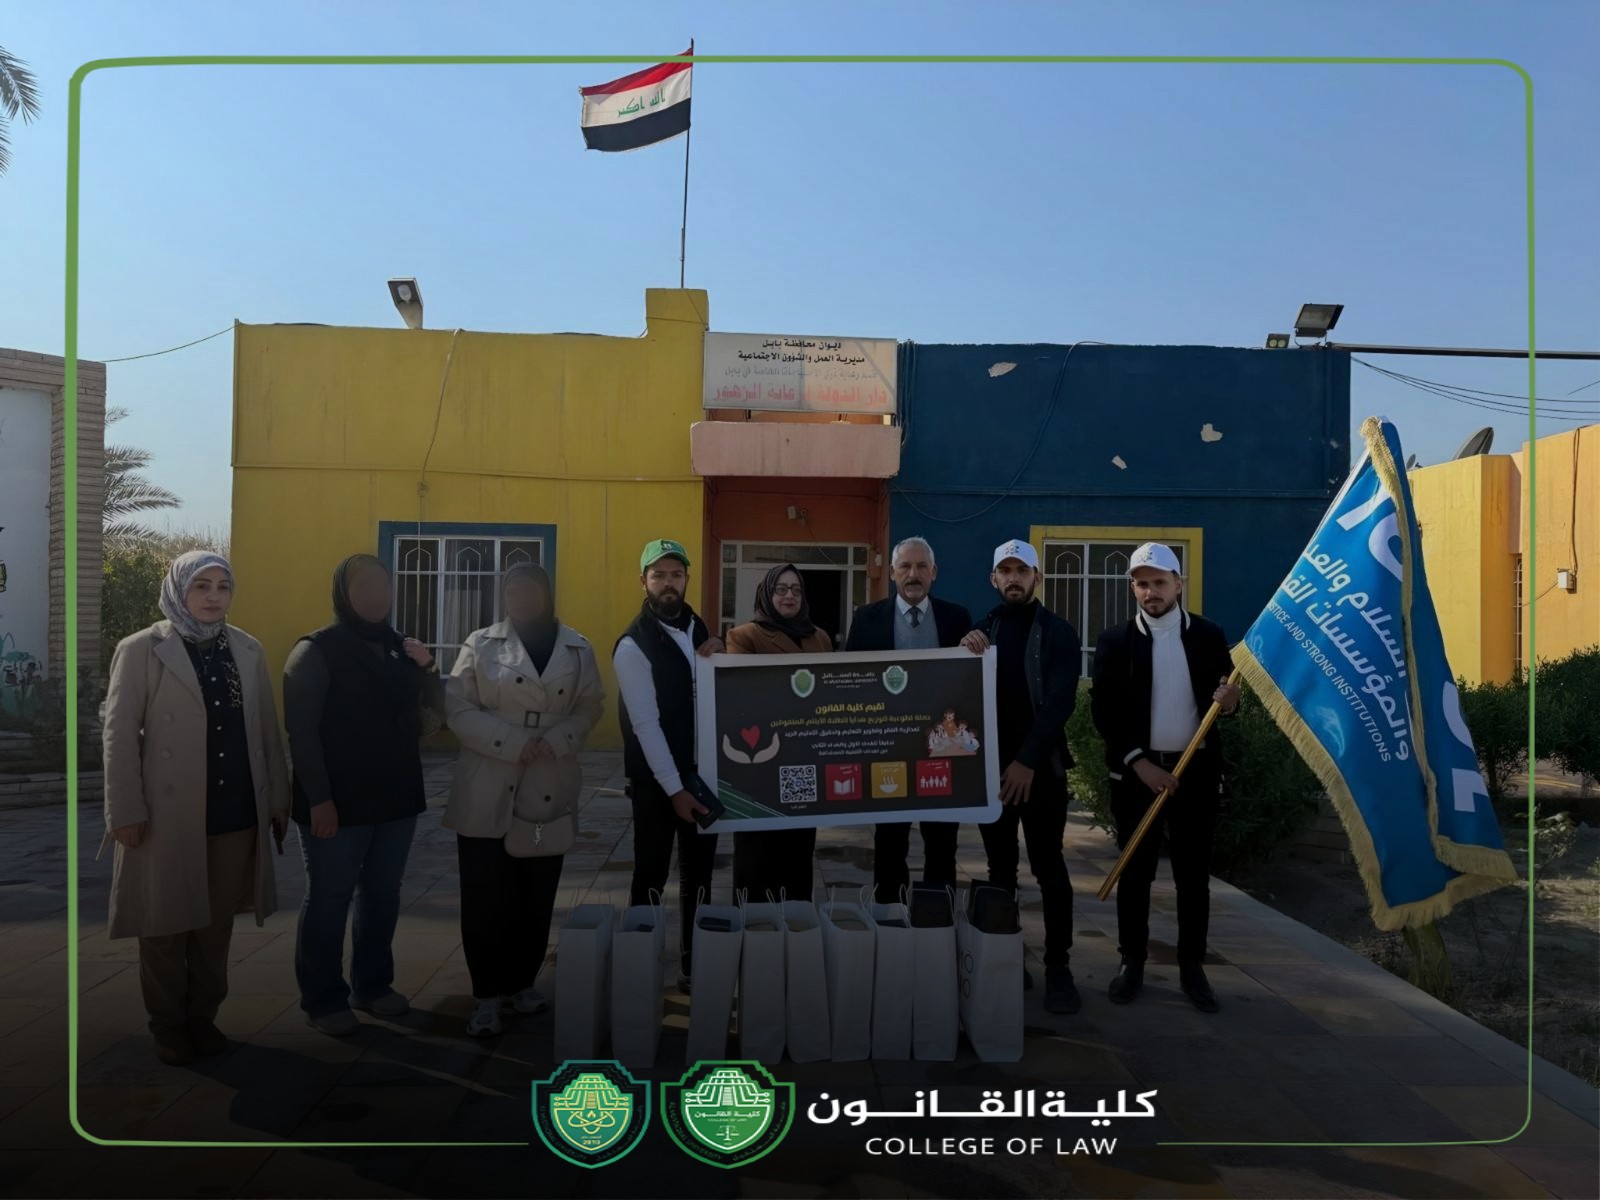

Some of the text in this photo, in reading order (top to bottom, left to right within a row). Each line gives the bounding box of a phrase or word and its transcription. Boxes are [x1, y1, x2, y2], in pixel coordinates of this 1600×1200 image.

[762, 338, 842, 352] ديوان محافظة بابل
[737, 350, 865, 366] مديرية العمل والشؤون الاجتماعية
[1268, 602, 1391, 763] STICE AND STRONG INSTITUTIONS
[1305, 601, 1409, 761] والمؤسسات
[815, 703, 845, 715] القانون
[847, 702, 864, 713] كلية
